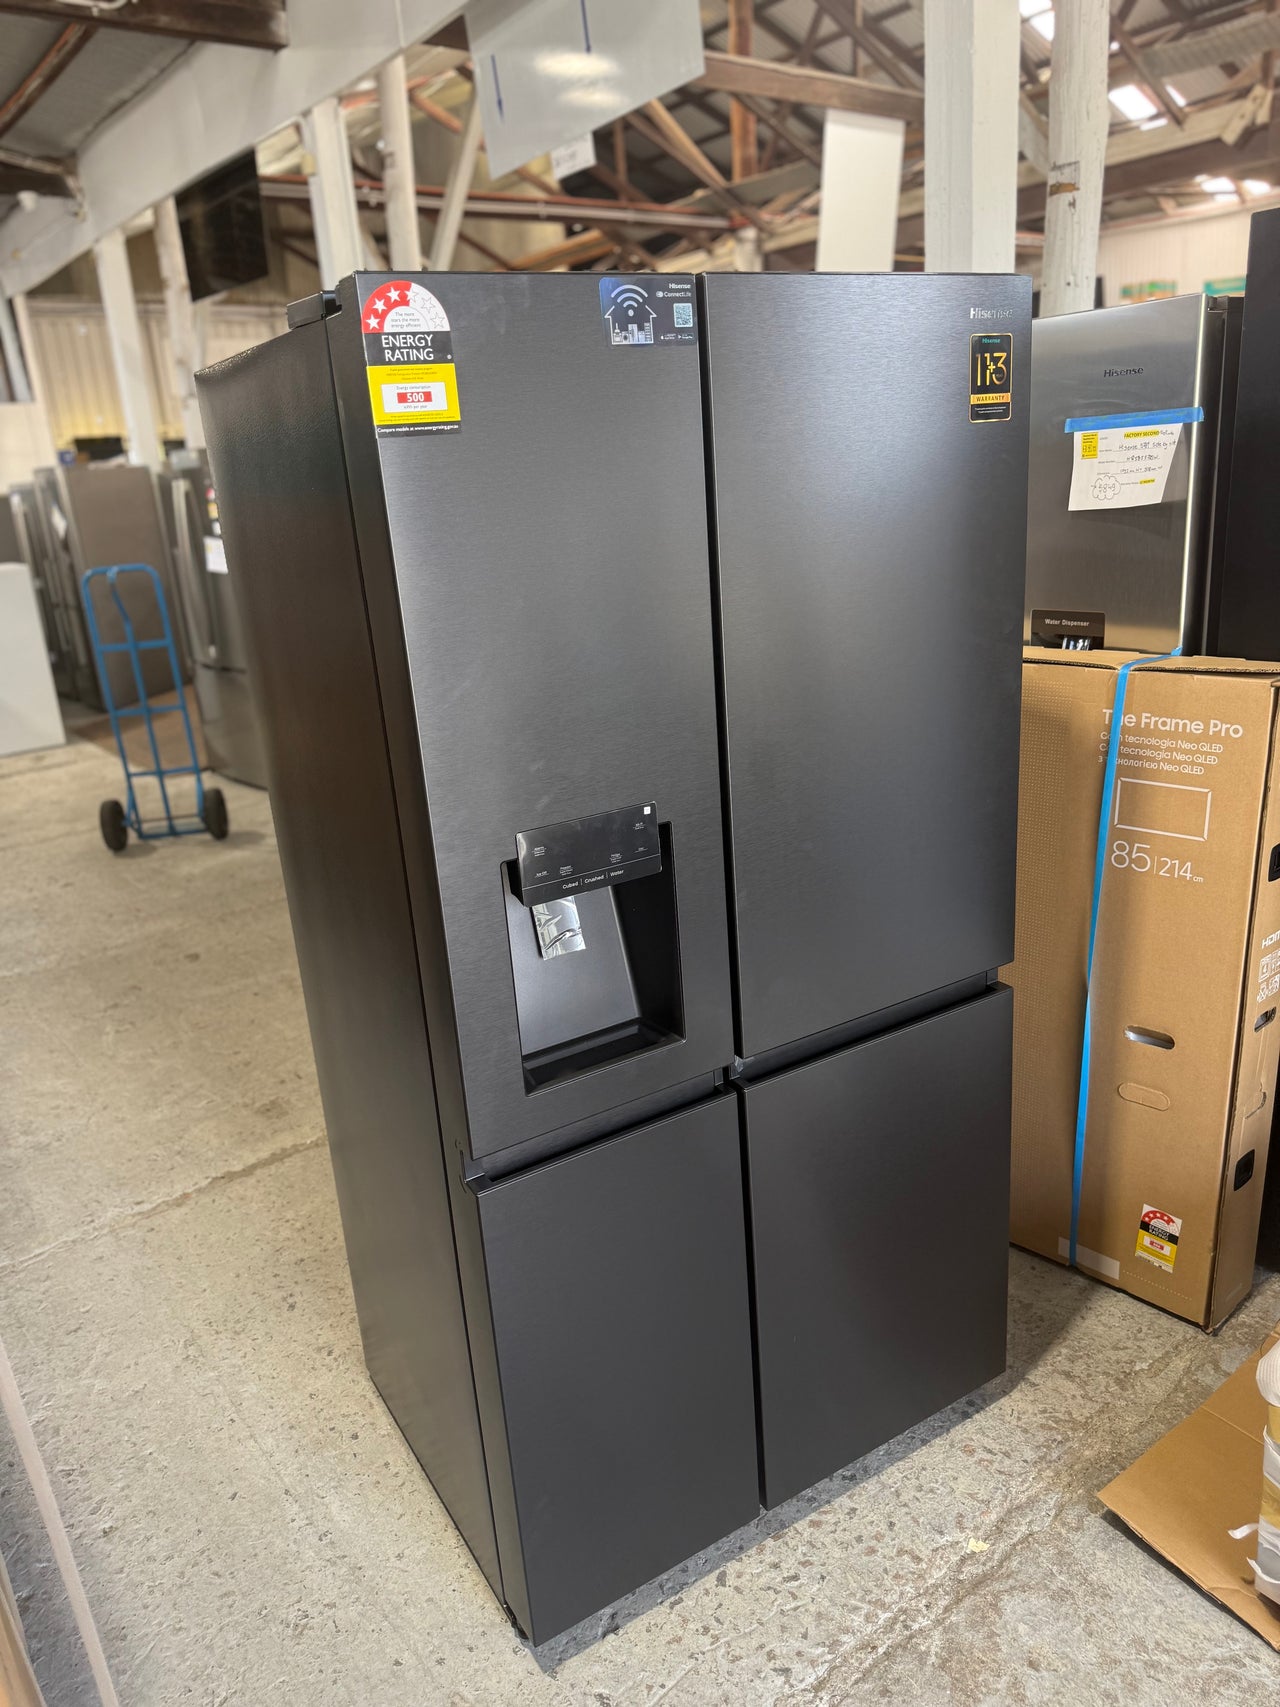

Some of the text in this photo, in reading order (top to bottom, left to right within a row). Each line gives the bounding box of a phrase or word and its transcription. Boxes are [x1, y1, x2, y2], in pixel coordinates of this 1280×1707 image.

[970, 308, 1012, 319] Hisense
[382, 334, 433, 348] ENERGY
[384, 348, 434, 362] RATING
[1104, 368, 1144, 378] Hisense
[406, 392, 424, 402] 500
[1102, 708, 1243, 738] Te Frame Pro
[1124, 734, 1176, 749] tecnologia
[1177, 740, 1198, 750] Neo
[1198, 742, 1224, 753] QLED
[1172, 752, 1192, 762] Neo
[1194, 754, 1218, 765] QLED
[1159, 762, 1180, 772] Neo
[1180, 764, 1204, 775] QLED
[1111, 840, 1151, 872] 85
[1158, 857, 1193, 880] 214
[562, 881, 578, 890] Cubed
[584, 874, 604, 884] Crushed
